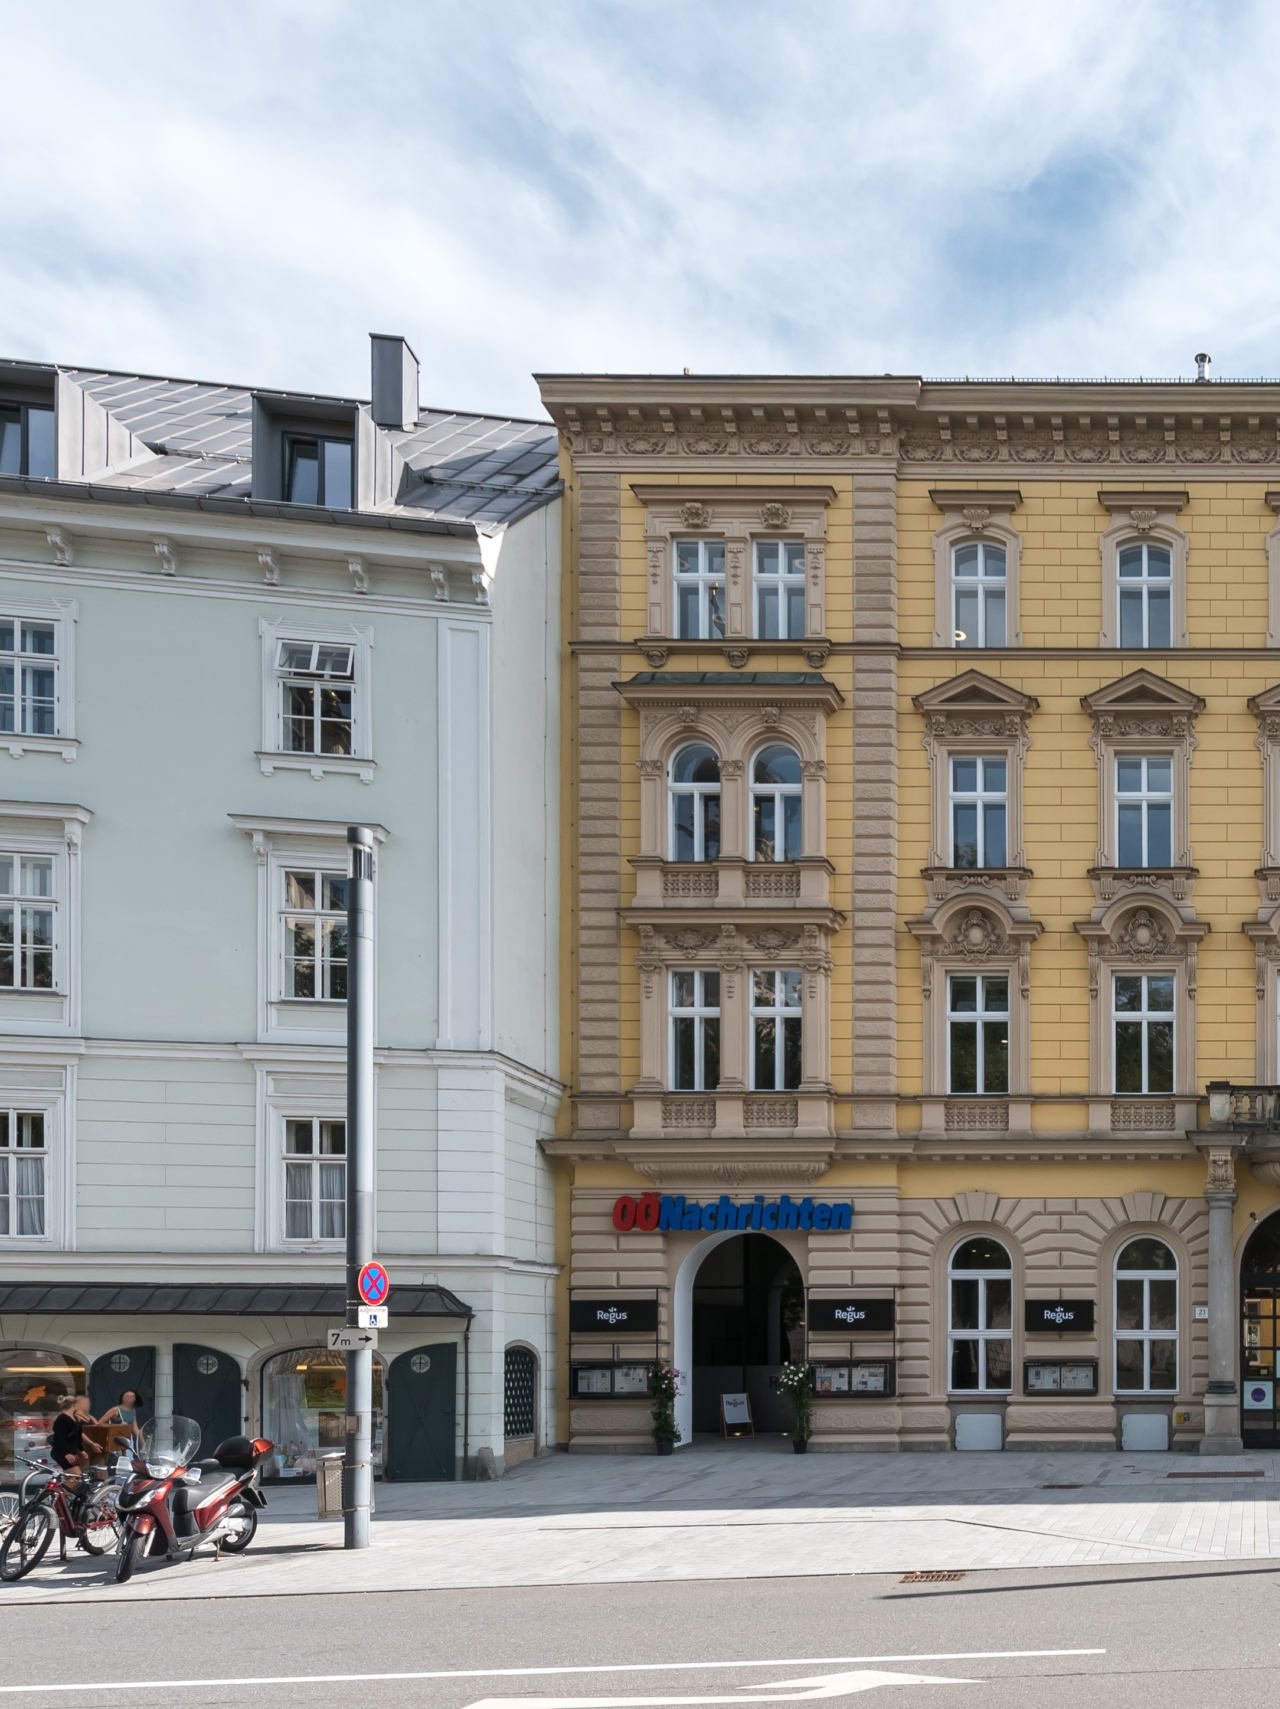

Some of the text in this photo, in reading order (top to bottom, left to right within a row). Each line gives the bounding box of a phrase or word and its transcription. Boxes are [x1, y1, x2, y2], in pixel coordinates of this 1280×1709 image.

[612, 1191, 852, 1232] OÖNachrichten
[596, 1307, 628, 1324] Regus
[835, 1306, 866, 1323] Regus
[1043, 1307, 1075, 1323] Regus
